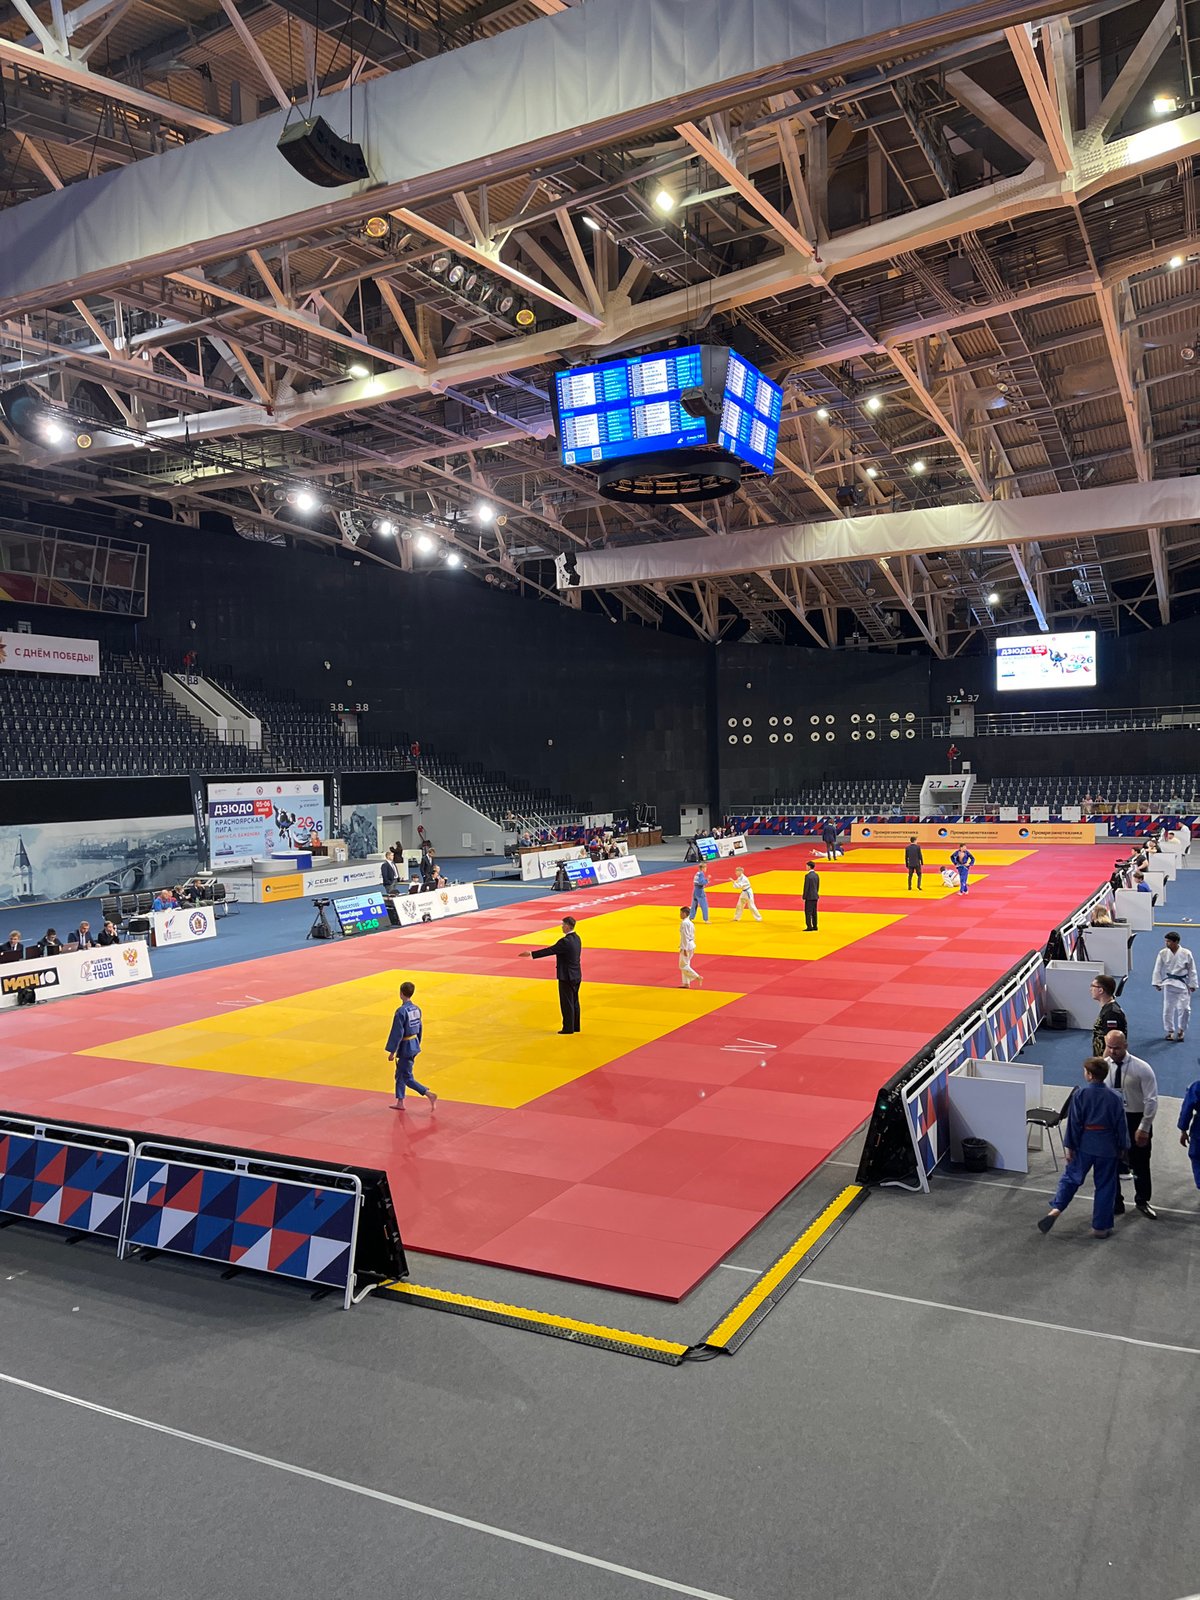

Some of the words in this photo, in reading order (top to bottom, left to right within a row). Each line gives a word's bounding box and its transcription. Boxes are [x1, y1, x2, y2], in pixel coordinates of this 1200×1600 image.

[14, 648, 21, 656] С
[23, 647, 51, 659] ДНЁМ
[52, 651, 94, 662] ПОБЕДЫ!
[1001, 647, 1032, 656] ДЗЮДО
[946, 695, 958, 703] 3.7
[967, 694, 980, 702] 3.7
[330, 703, 344, 712] 3.8
[355, 703, 369, 712] 3.8
[929, 780, 942, 789] 2.7
[953, 780, 966, 788] 2.7
[214, 803, 254, 816] ДЗЮДО
[214, 817, 264, 826] КРАСНОЯРСКАЯ
[355, 918, 380, 931] 1:26
[91, 962, 114, 973] JUDO
[93, 970, 115, 980] TOUR
